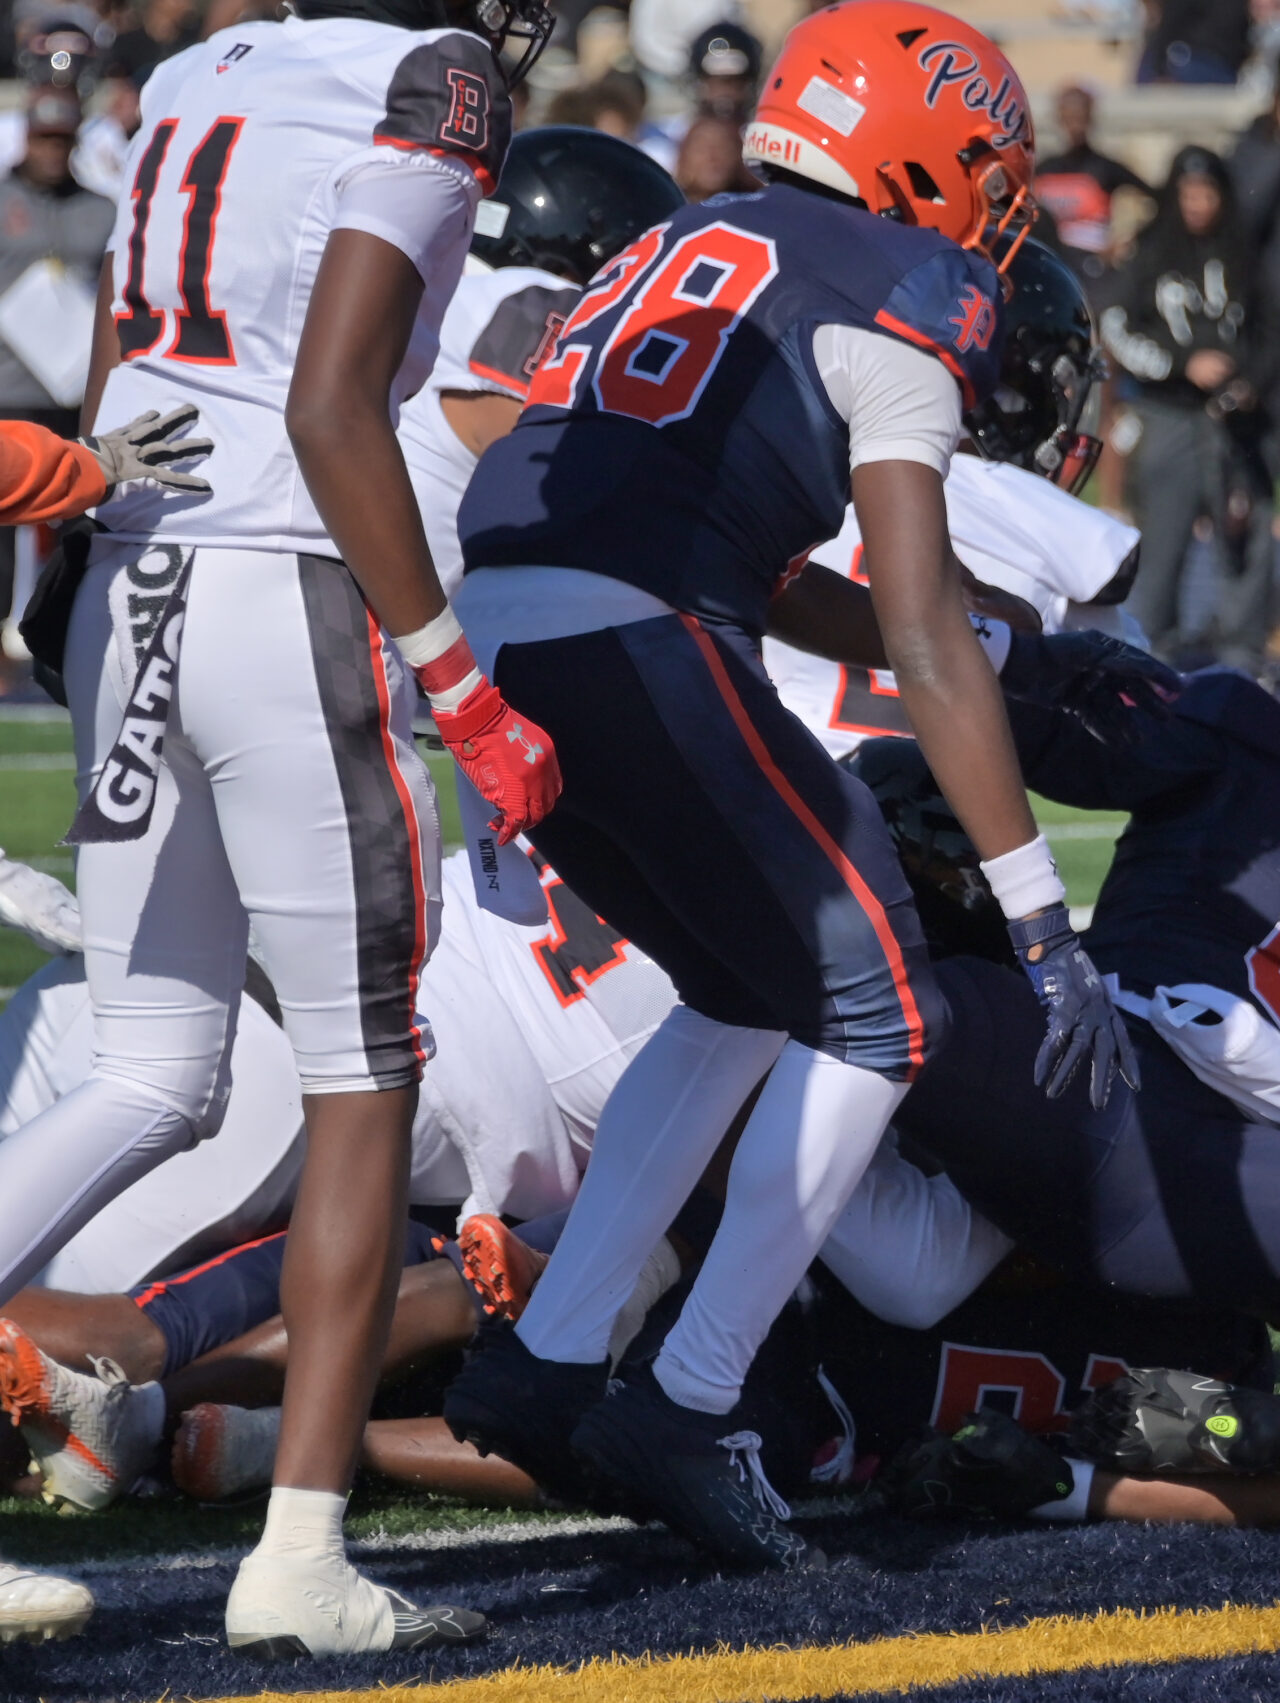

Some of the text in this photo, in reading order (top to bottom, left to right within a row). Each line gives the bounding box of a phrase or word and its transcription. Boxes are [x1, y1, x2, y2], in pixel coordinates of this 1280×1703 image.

[440, 68, 488, 151] B
[917, 41, 1026, 150] Poly
[114, 115, 247, 367] 11
[520, 220, 779, 429] 28
[478, 838, 498, 873] NXTRND
